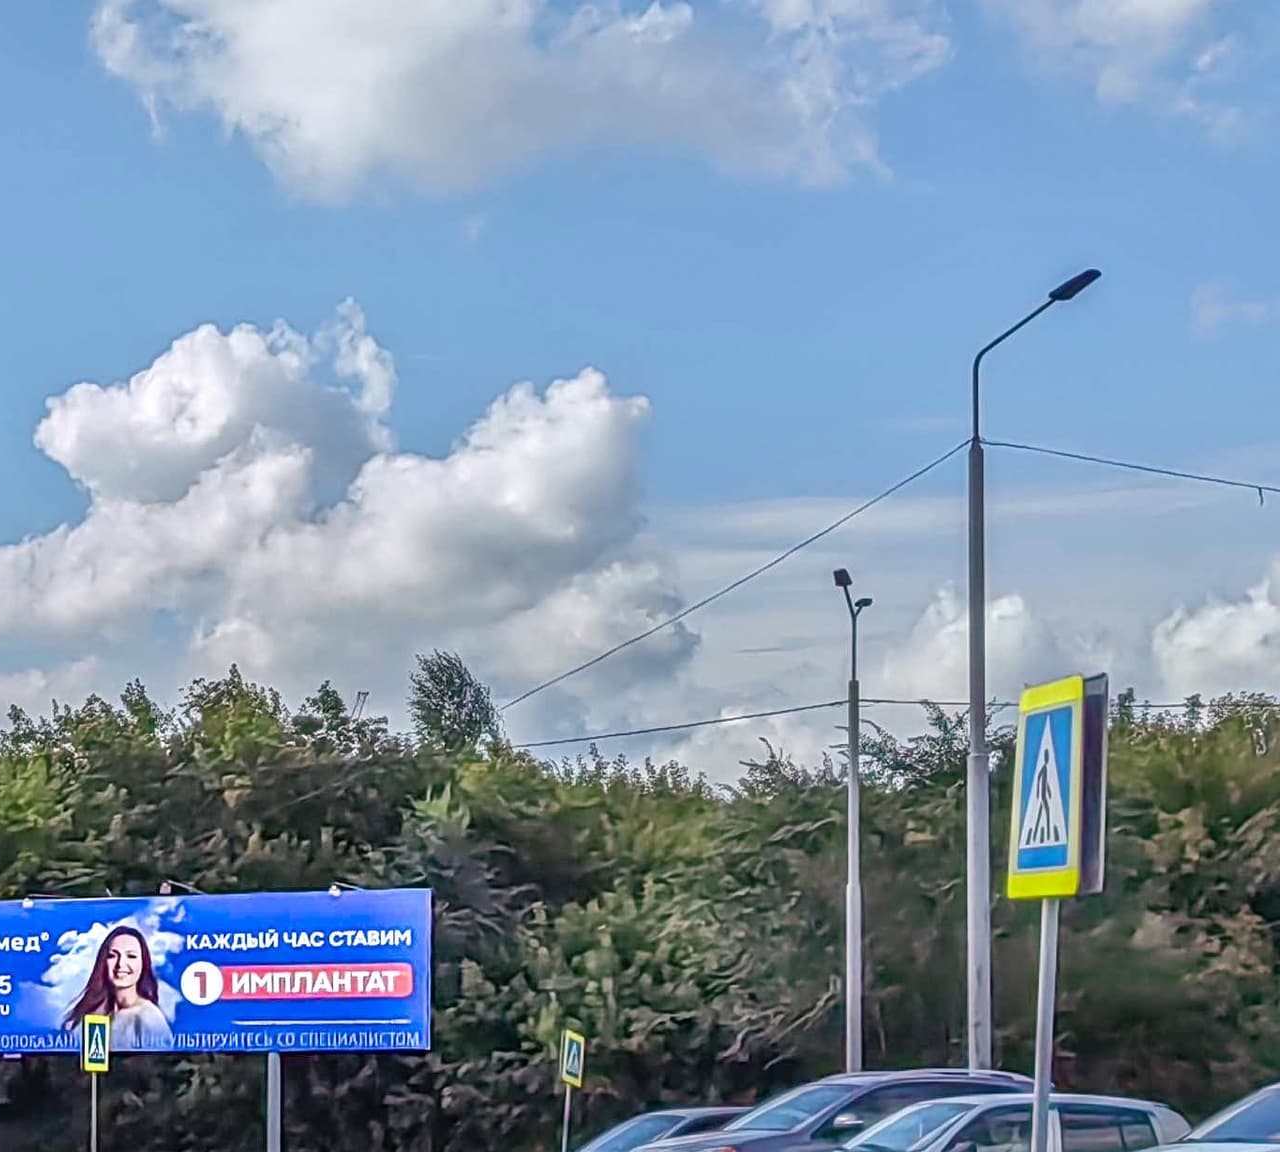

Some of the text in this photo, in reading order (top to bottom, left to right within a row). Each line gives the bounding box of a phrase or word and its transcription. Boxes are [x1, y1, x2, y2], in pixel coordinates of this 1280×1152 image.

[186, 929, 412, 951] КАЖДЫЙ ЧАС СТАВИМ
[193, 970, 400, 999] 1 ИМПЛАНТАТ
[277, 1031, 295, 1048] СО
[300, 1030, 420, 1048] СПЕЦИАЛИСТОМ
